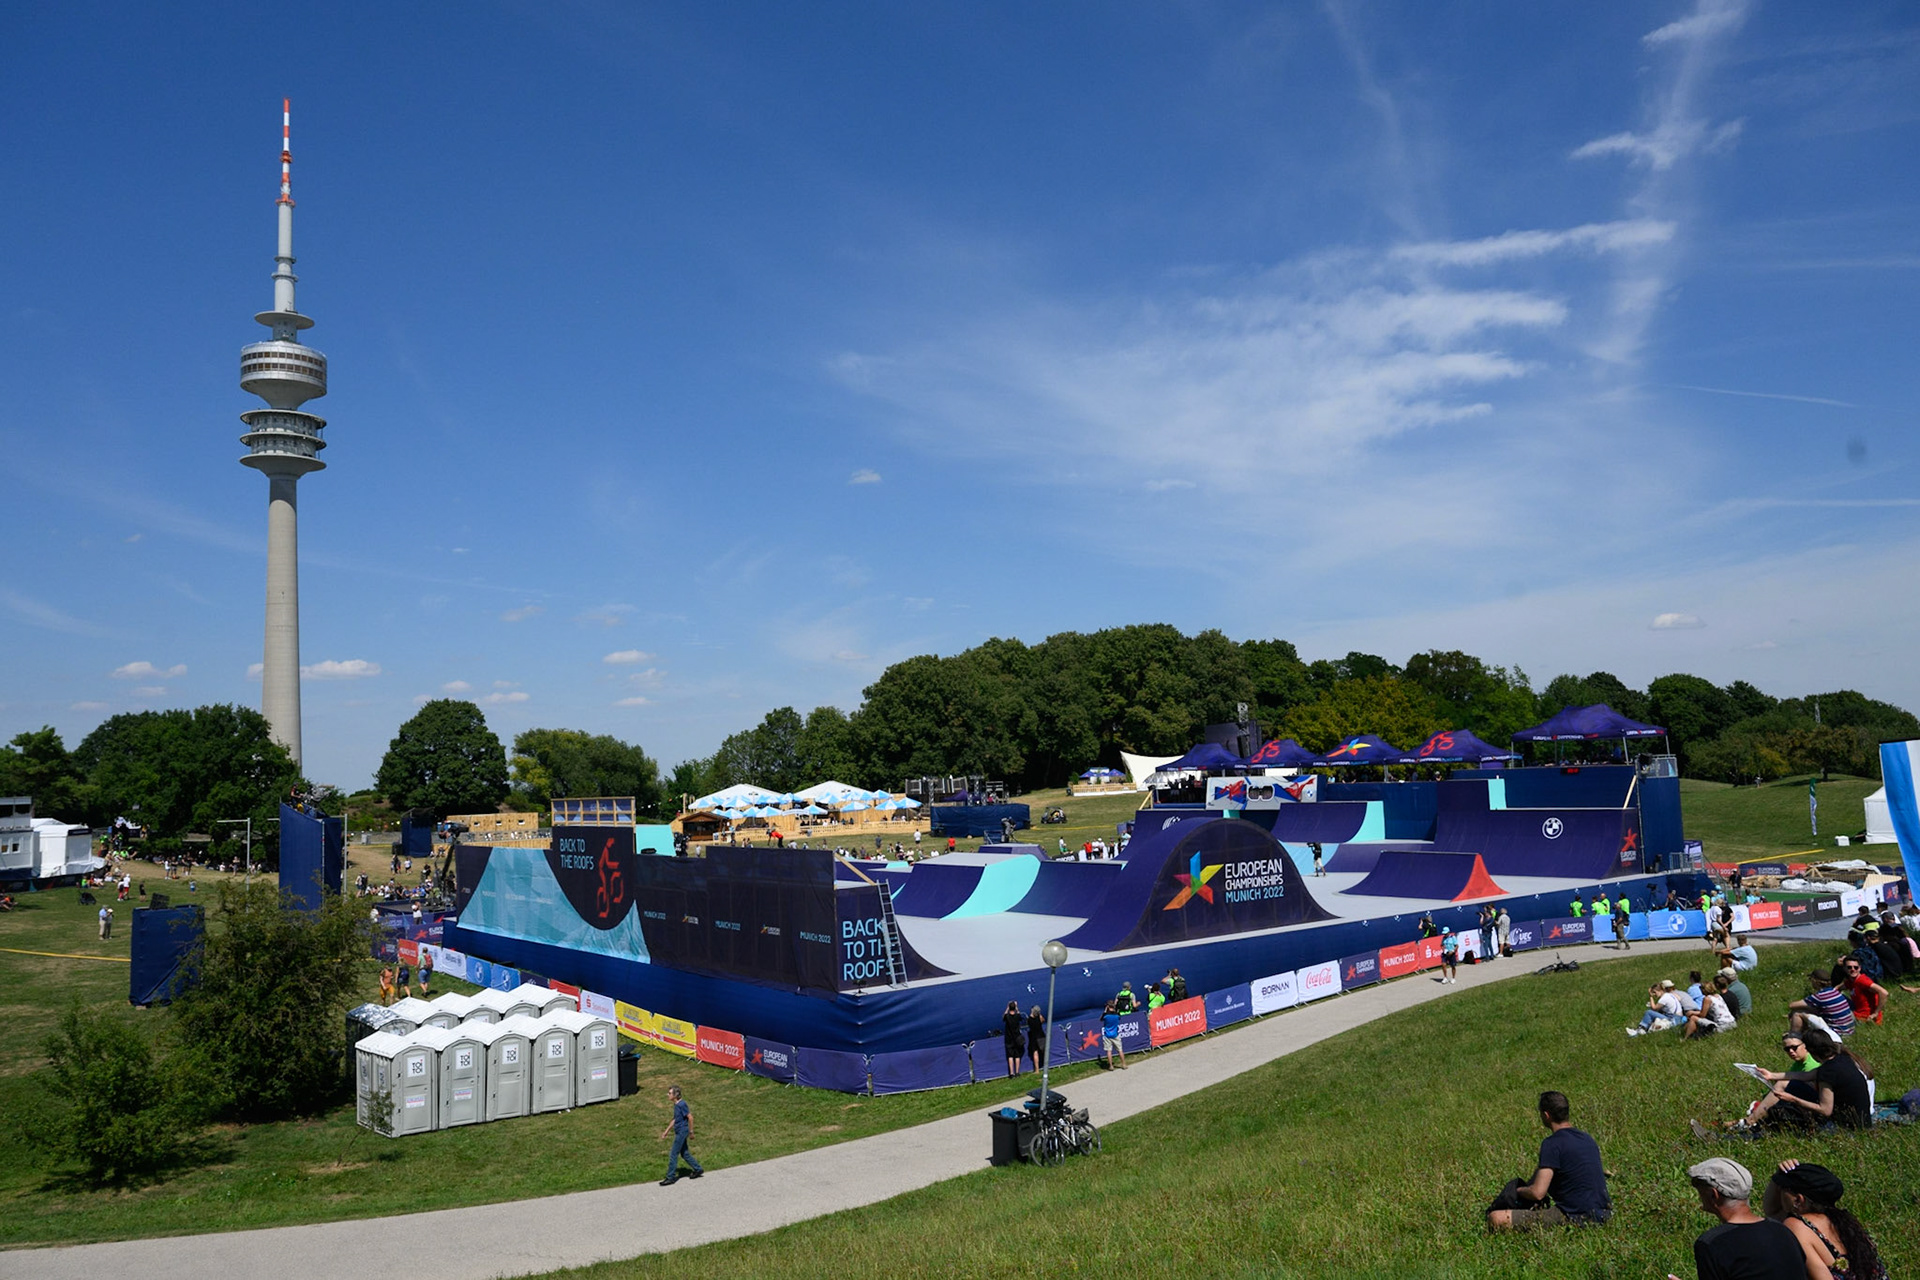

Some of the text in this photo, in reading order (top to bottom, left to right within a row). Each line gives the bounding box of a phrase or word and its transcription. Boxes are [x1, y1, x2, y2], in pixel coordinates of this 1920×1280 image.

[560, 838, 586, 853] BACK TO
[560, 854, 594, 870] THE ROOFS
[1225, 858, 1283, 879] EUROPEAN
[1225, 874, 1284, 891] CHAMPIONSHIPS
[1225, 886, 1284, 903] MUNICH 2022
[842, 918, 884, 939] BACK
[800, 931, 831, 944] MUNICH 2022
[843, 941, 865, 959] TO
[1383, 952, 1416, 968] MUNICH 2022
[1261, 982, 1290, 996] BORNAN
[1156, 1010, 1201, 1031] MUNICH 2022
[700, 1038, 739, 1056] MUNICH 2022
[764, 1049, 788, 1062] EUROPEAN
